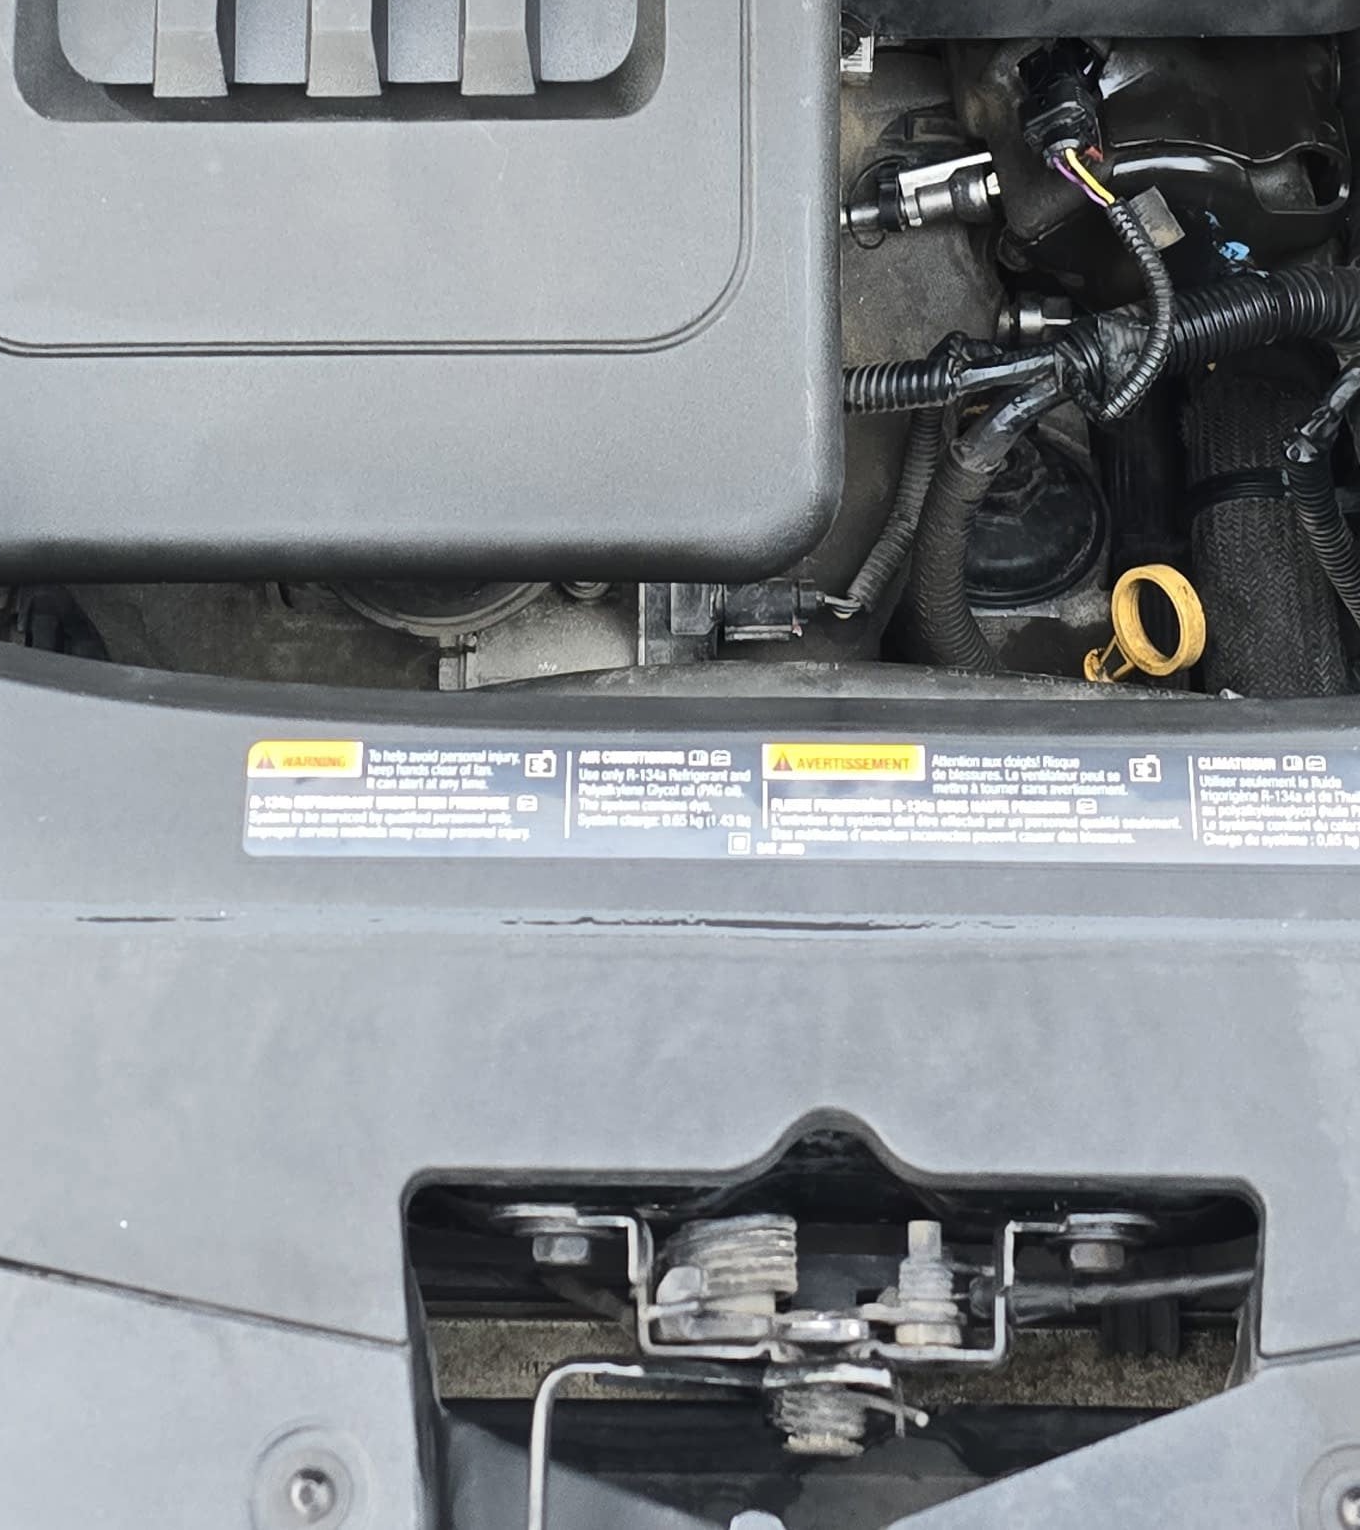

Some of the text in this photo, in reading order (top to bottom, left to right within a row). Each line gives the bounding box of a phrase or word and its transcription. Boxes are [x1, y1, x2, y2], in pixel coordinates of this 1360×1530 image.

[282, 756, 346, 768] WARNING
[382, 750, 407, 765] help
[408, 750, 438, 763] avoid
[439, 751, 486, 766] personal
[487, 752, 519, 767] injury,
[796, 757, 911, 771] AVERTISSEMENT
[625, 769, 667, 782] R-134a
